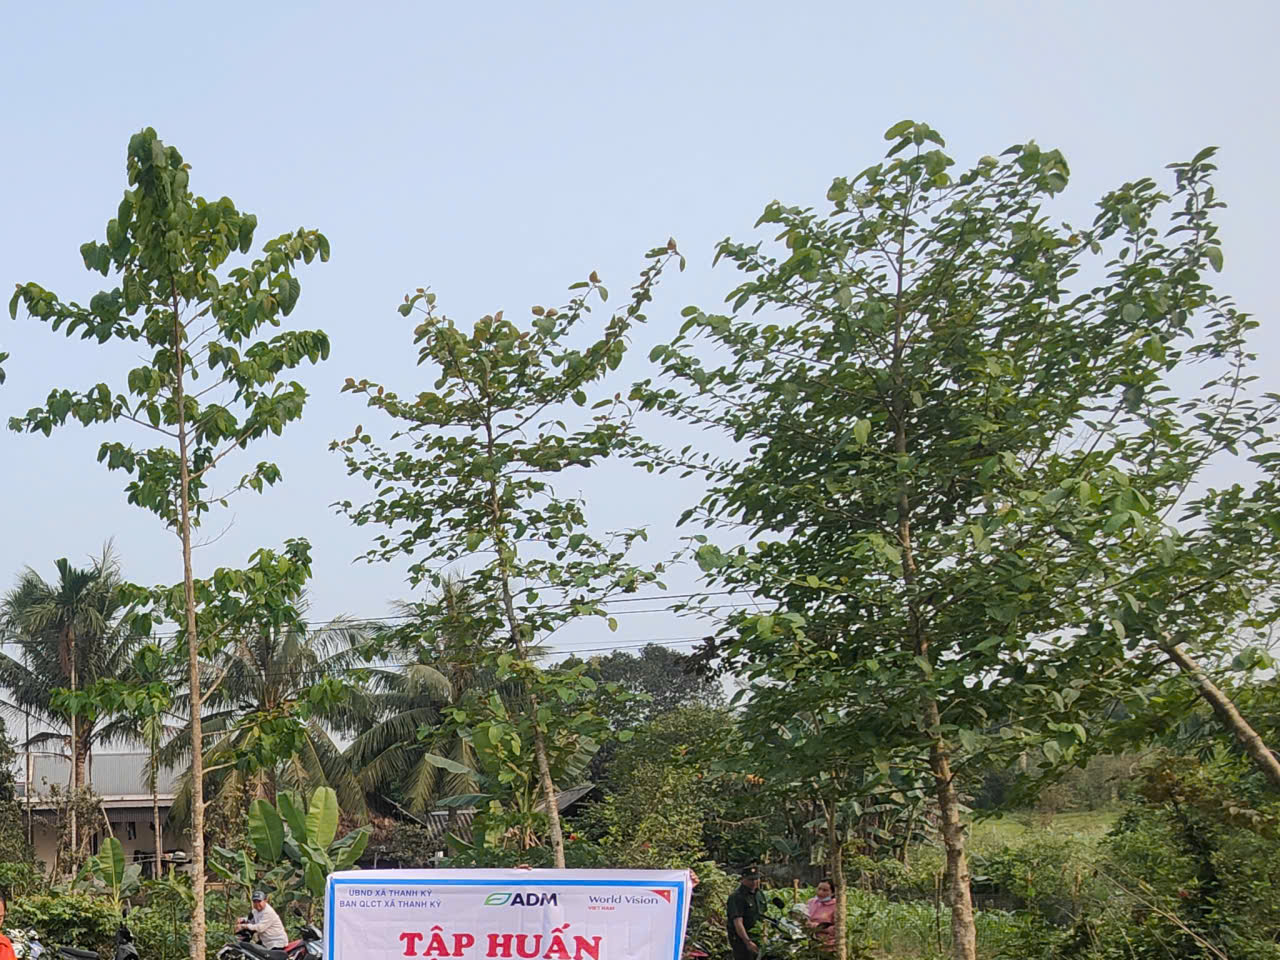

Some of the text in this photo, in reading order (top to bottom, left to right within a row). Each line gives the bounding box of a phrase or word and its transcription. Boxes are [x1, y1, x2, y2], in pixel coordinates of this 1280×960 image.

[349, 889, 373, 897] UBND
[389, 889, 418, 897] THANH
[339, 900, 357, 908] BAN
[359, 900, 381, 908] QLCT
[397, 900, 428, 908] THANH
[510, 892, 558, 907] ADM
[588, 895, 659, 905] World Vision
[486, 923, 602, 960] HUẤN
